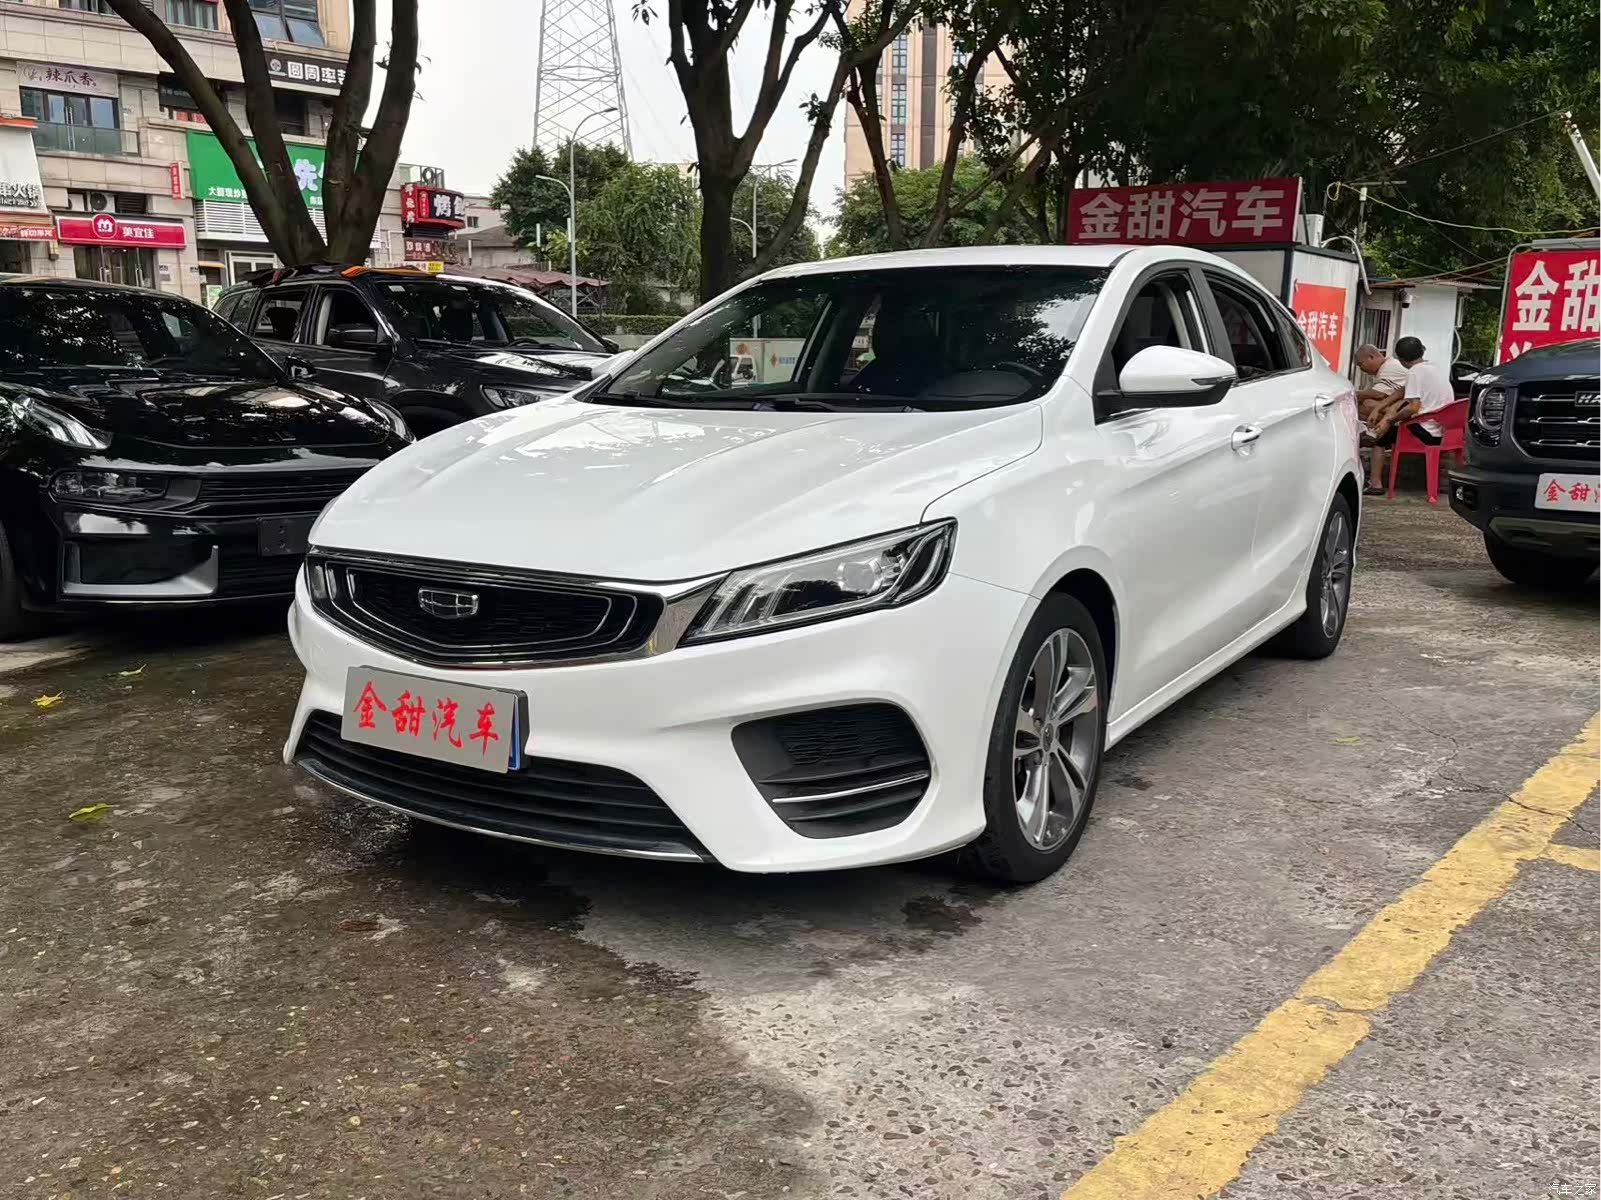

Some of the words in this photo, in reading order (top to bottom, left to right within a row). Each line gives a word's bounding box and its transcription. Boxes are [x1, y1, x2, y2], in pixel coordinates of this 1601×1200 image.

[45, 67, 93, 87] 辣爪香
[123, 226, 154, 239] 美宜佳
[1078, 185, 1285, 240] 金甜汽车
[1512, 260, 1600, 333] 金甜
[1298, 310, 1338, 342] 金甜汽车
[353, 681, 499, 756] 金甜汽车
